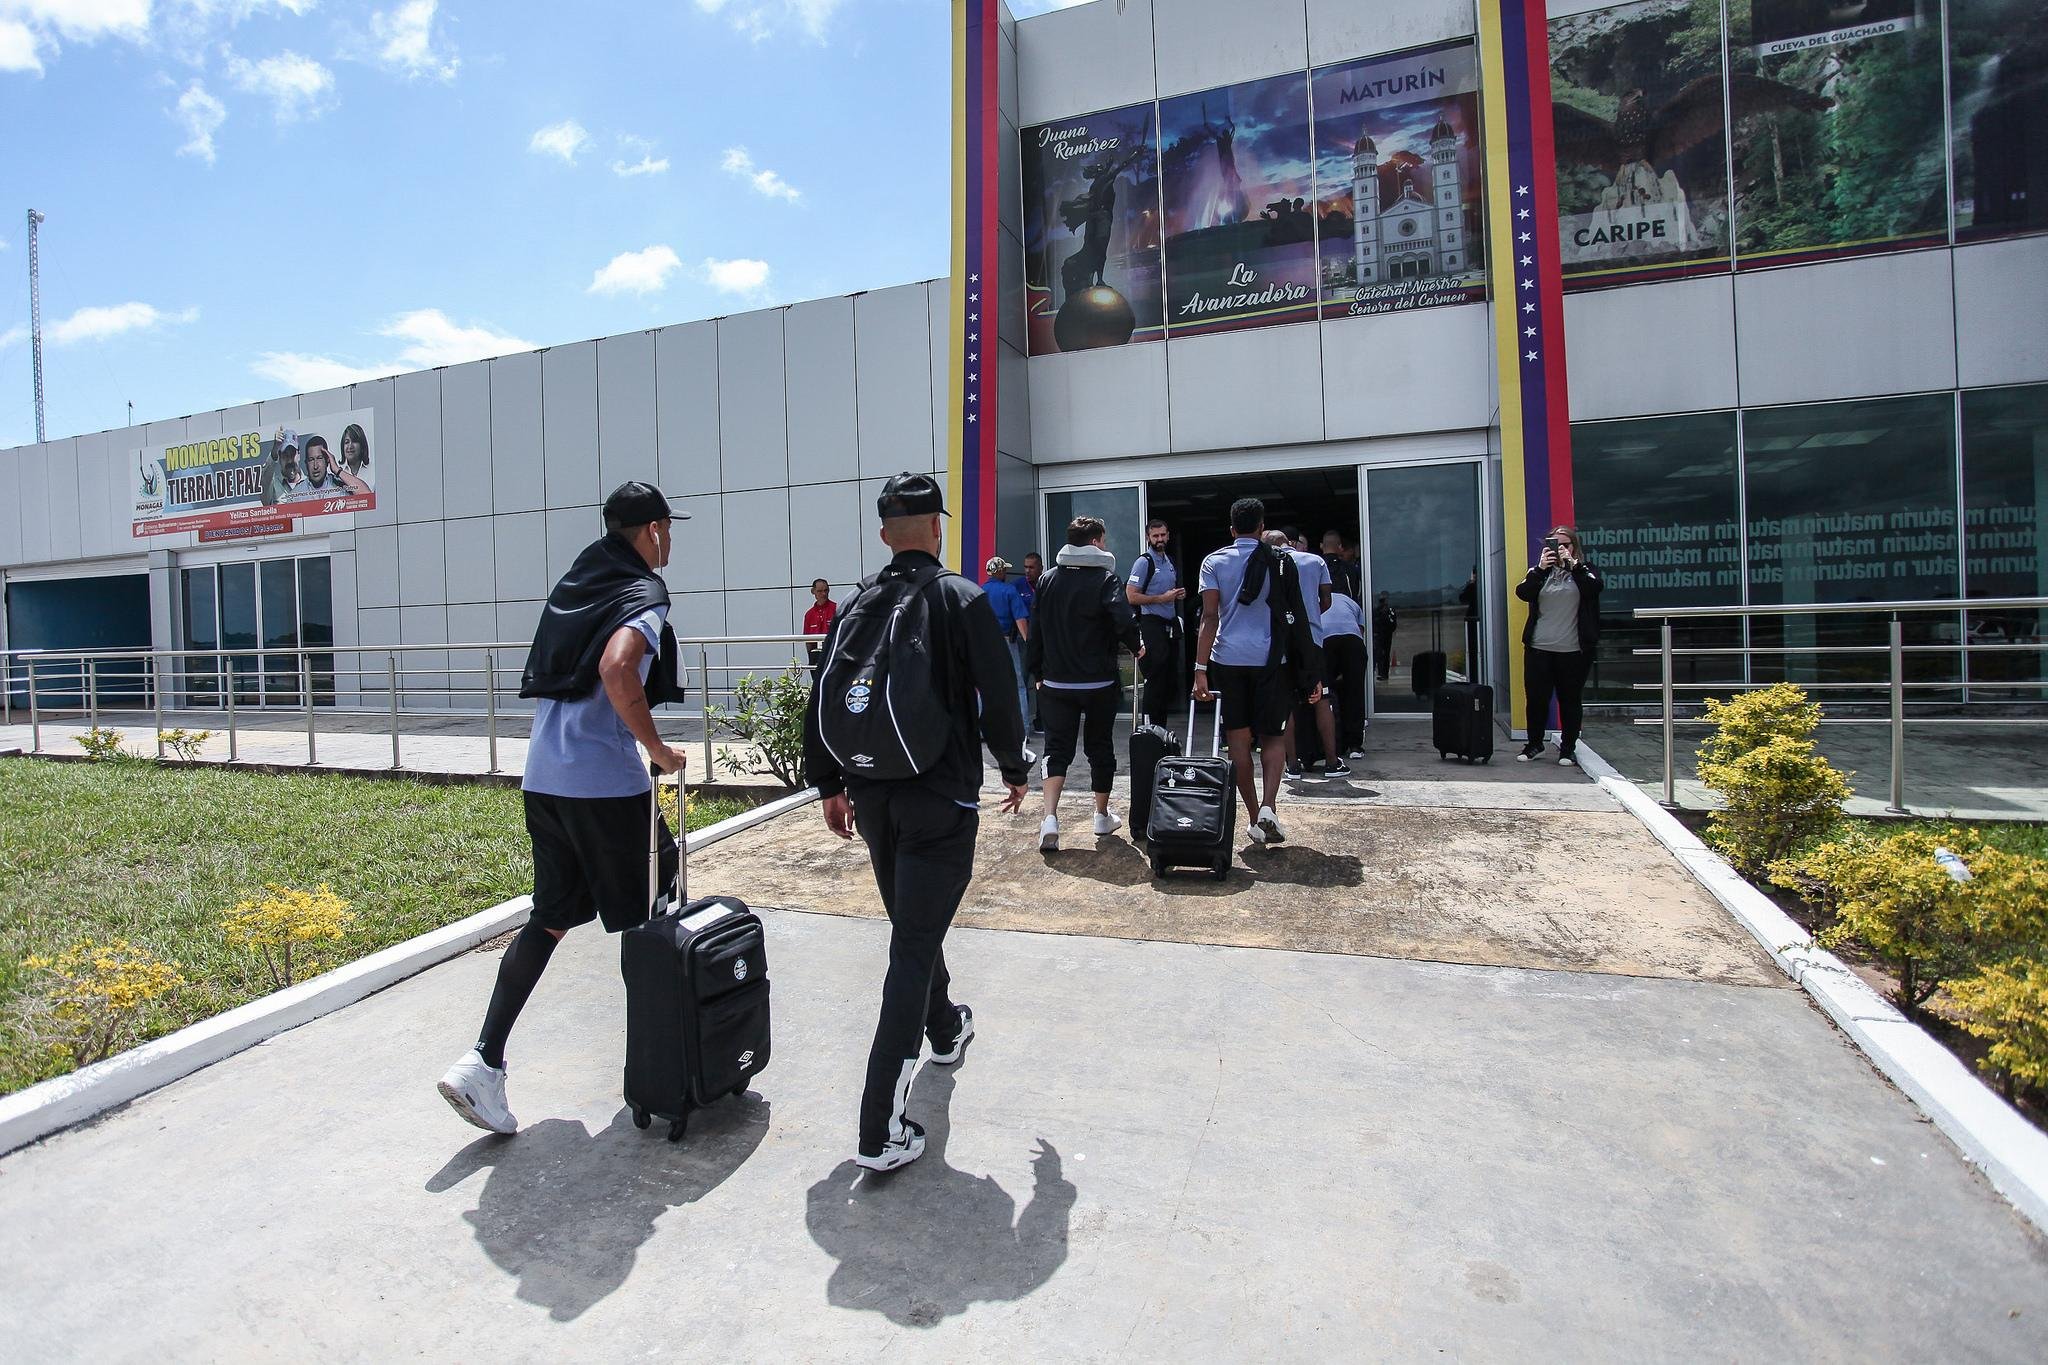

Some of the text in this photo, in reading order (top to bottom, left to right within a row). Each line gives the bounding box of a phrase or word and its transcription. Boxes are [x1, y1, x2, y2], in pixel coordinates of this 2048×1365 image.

[1771, 41, 1805, 53] CUEVA
[1808, 37, 1829, 46] DEL
[1340, 66, 1446, 105] MATURÍN
[1038, 126, 1089, 148] Juana
[1053, 137, 1121, 160] Ramírez
[1573, 219, 1666, 248] CARIPE
[1226, 261, 1258, 288] La
[1179, 281, 1310, 316] Avanzadora
[1355, 277, 1463, 301] Catedral Nuestra
[1348, 292, 1468, 315] Señora del Carmen
[166, 432, 261, 471] MONAGAS ES
[167, 464, 264, 506] TIERRA DE PAZ
[136, 502, 163, 511] MONAGAS
